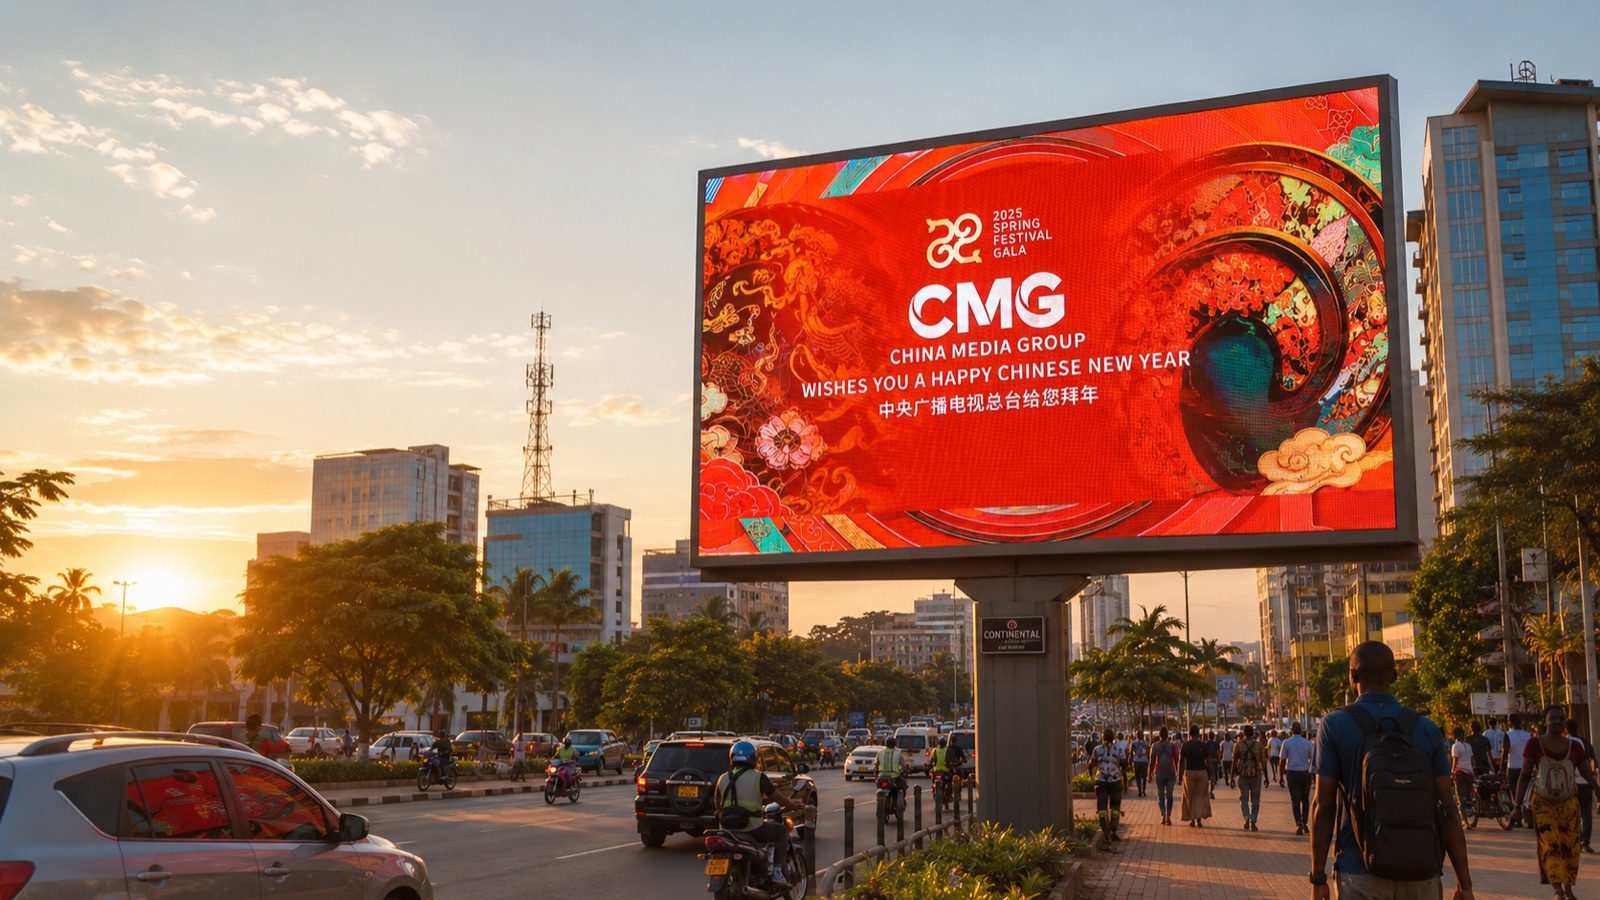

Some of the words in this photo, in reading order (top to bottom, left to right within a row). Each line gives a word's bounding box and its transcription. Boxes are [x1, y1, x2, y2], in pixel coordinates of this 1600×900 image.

[993, 207, 1023, 221] 2025
[993, 218, 1040, 234] SPRING
[993, 229, 1053, 246] FESTIVAL
[993, 244, 1027, 258] GALA
[908, 271, 1065, 339] CMG
[890, 345, 946, 364] CHINA
[951, 339, 1012, 359] MEDIA
[1017, 332, 1086, 352] GROUP
[802, 378, 868, 398] WISHES
[873, 374, 909, 392] YOU
[914, 373, 926, 388] A
[931, 366, 992, 387] HAPPY
[997, 359, 1081, 381] CHINESE
[1088, 355, 1133, 374] NEW
[1139, 350, 1191, 370] YEAR
[879, 385, 1099, 419] 中央广播电视总台给您拜年
[984, 630, 1041, 639] CONTINENTAL
